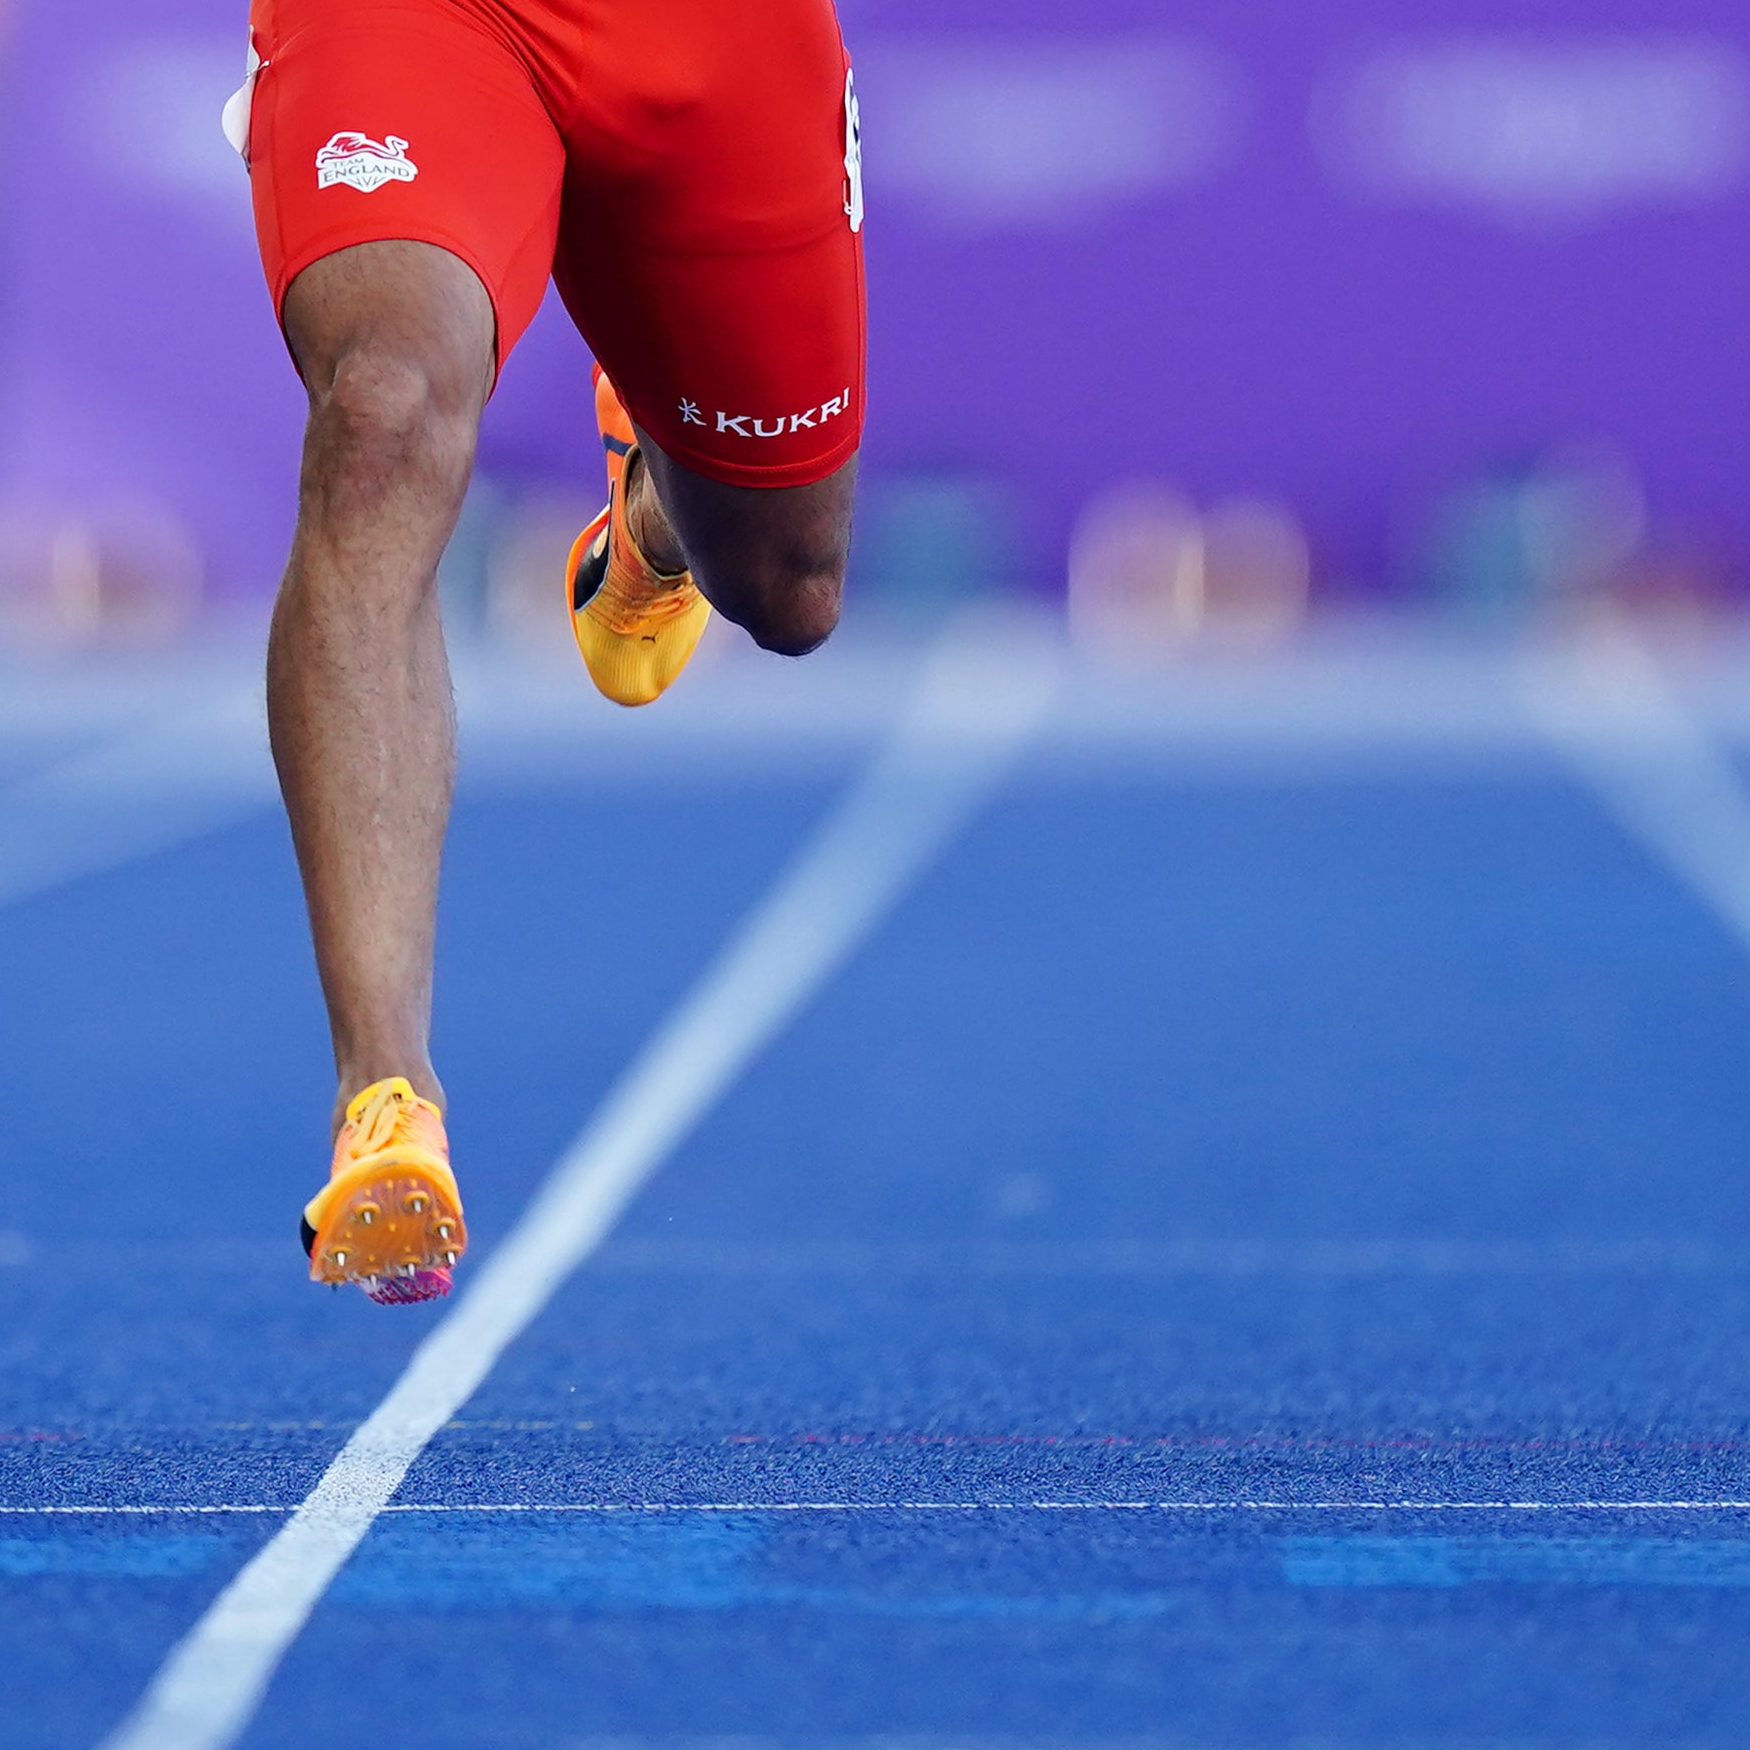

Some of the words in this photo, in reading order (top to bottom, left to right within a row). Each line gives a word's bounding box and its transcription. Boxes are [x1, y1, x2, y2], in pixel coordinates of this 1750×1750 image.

[332, 158, 364, 169] TEAM
[323, 164, 410, 183] ENGLAND
[715, 386, 850, 437] KUKRI
